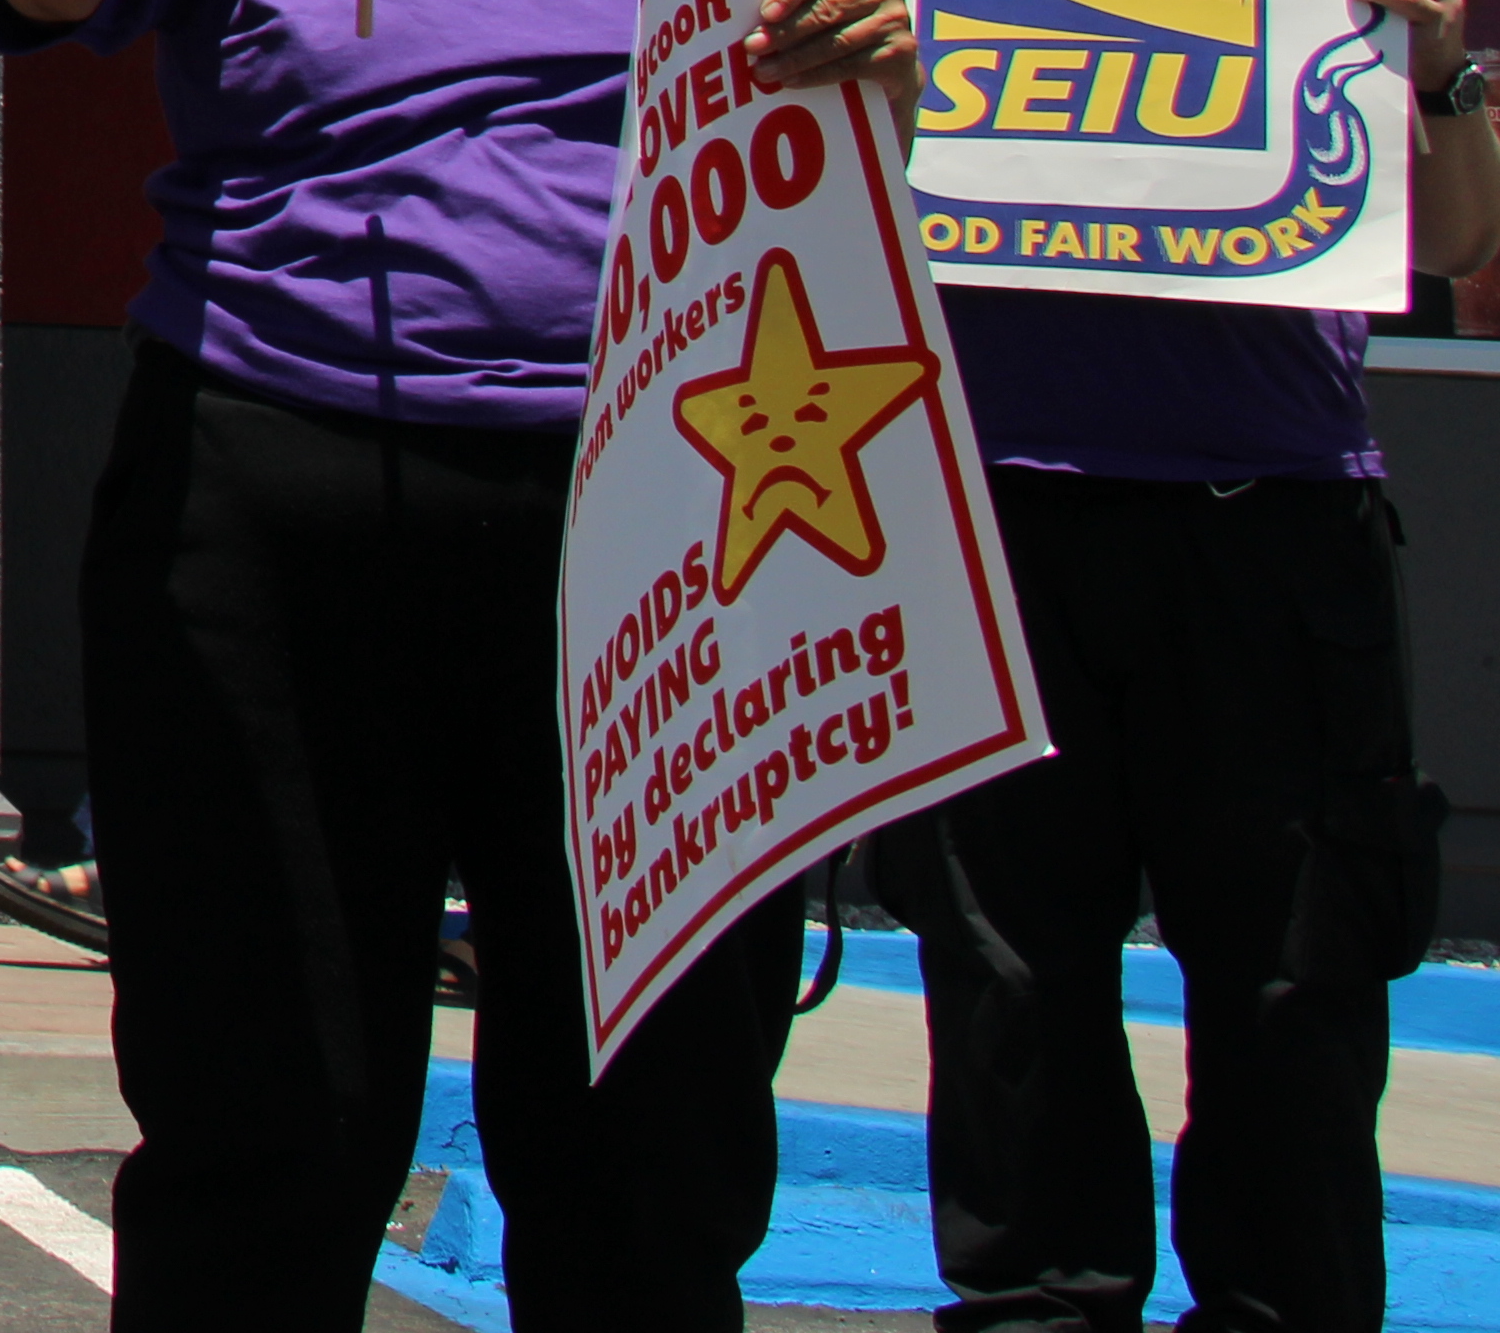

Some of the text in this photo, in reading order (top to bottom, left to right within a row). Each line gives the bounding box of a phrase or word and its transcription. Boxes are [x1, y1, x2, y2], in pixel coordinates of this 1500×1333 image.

[916, 47, 1255, 138] SEIU
[593, 104, 825, 394] 0,000
[1019, 219, 1142, 263] FAIR
[1157, 186, 1348, 266] WORK
[616, 272, 747, 422] workers
[579, 540, 711, 737] AVOIDS
[584, 617, 722, 823] PAYING
[590, 602, 906, 899] by declaring
[601, 670, 915, 974] bankruptcy!
